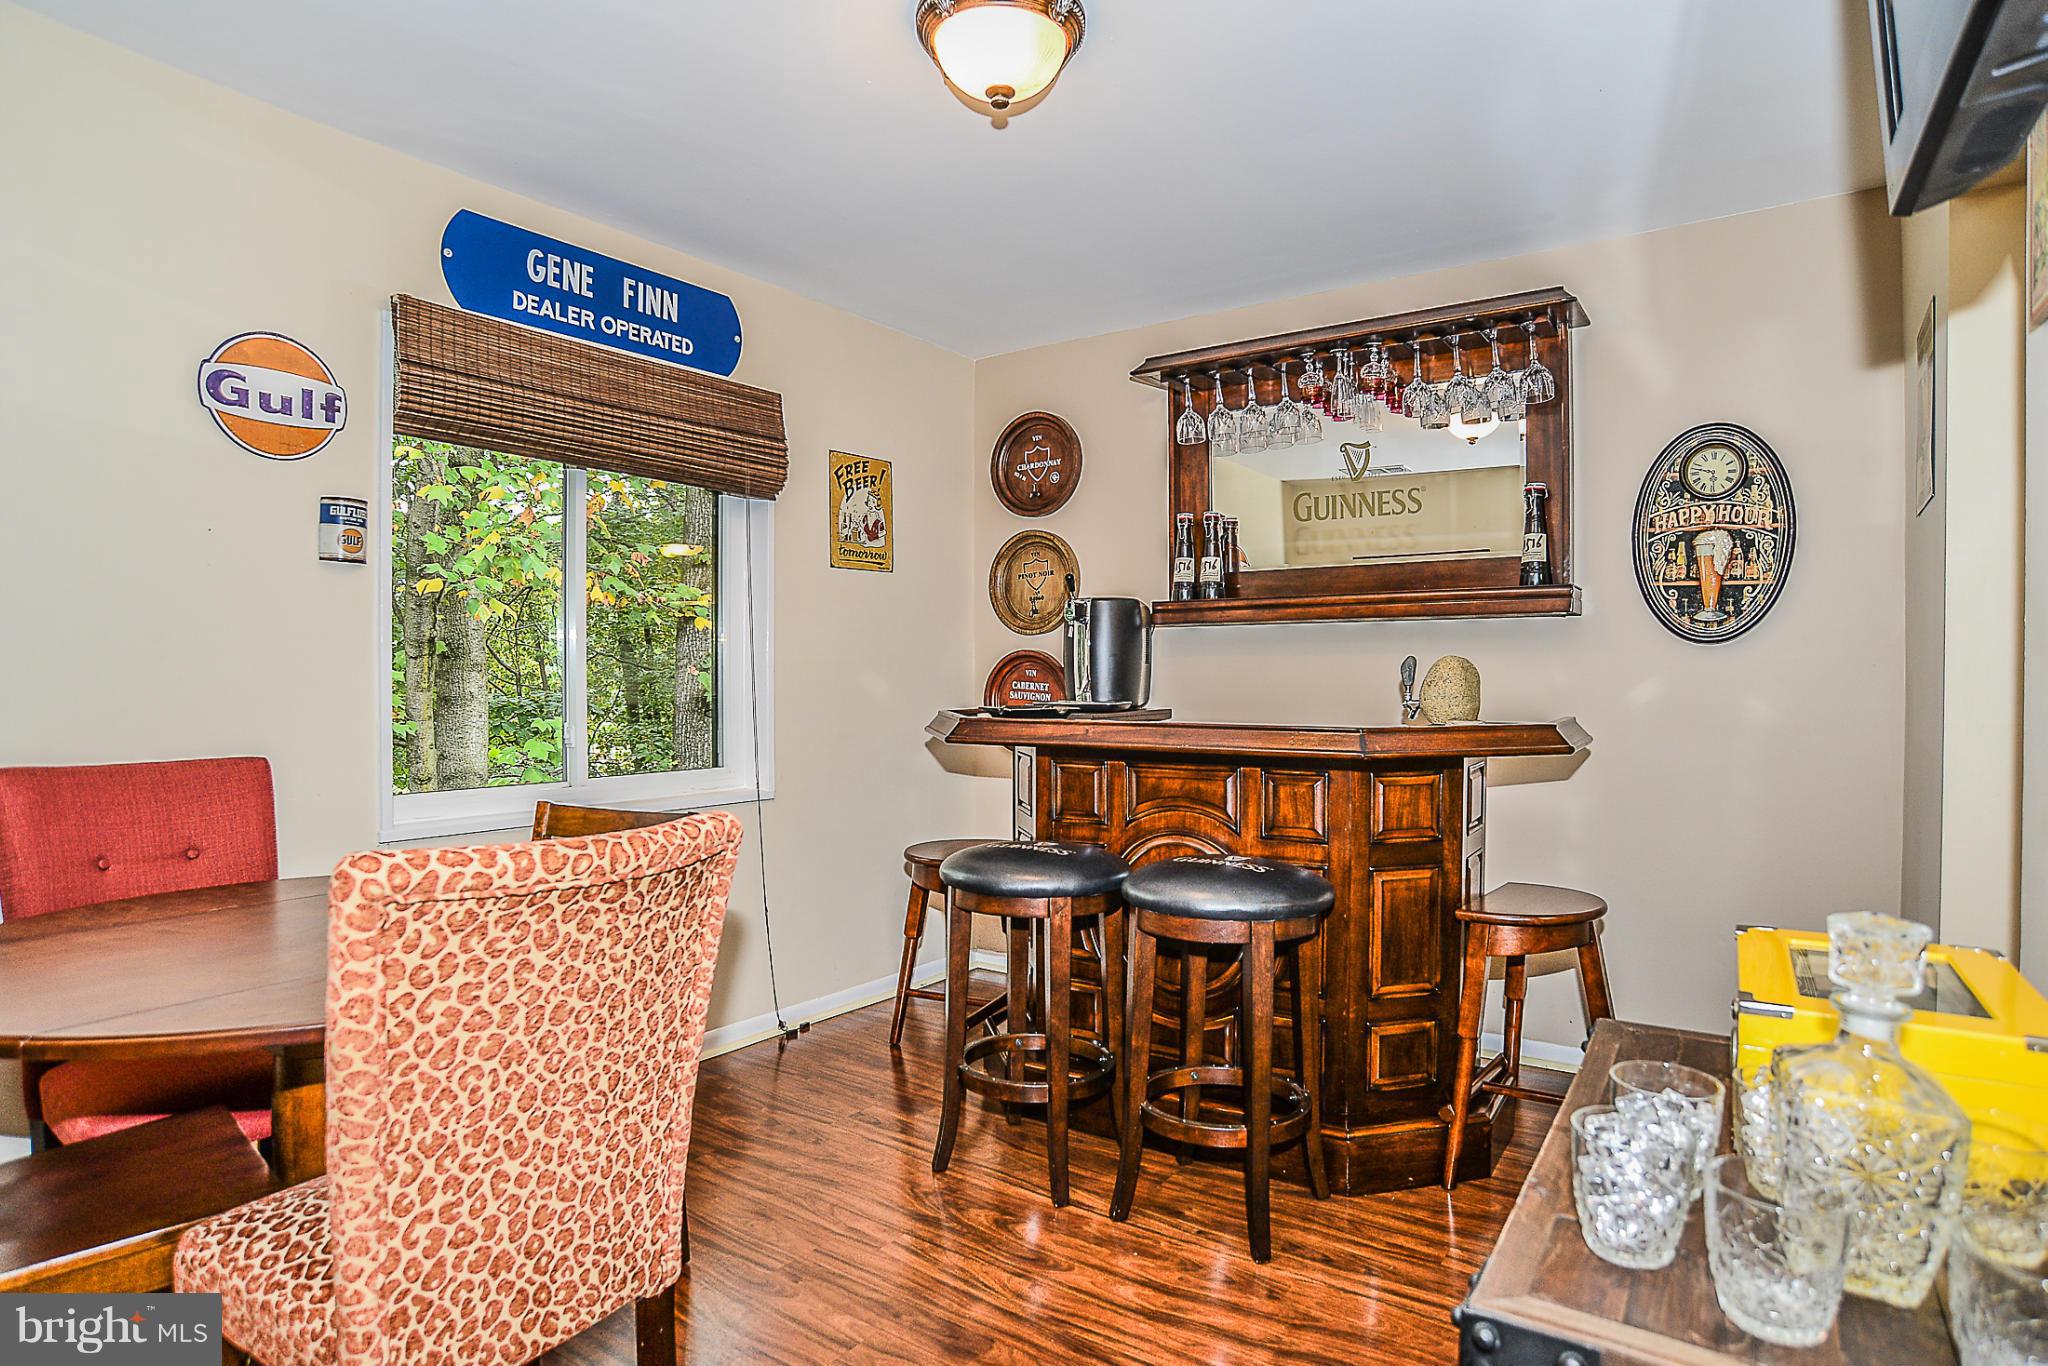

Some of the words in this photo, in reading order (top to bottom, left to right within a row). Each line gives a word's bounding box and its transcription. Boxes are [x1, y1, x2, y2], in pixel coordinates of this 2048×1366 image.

[527, 249, 594, 299] GENE
[623, 277, 678, 323] FINN
[512, 290, 595, 330] DEALER
[600, 316, 694, 355] OPERATED
[206, 369, 342, 423] Gulf
[834, 460, 869, 490] FREE
[1017, 458, 1061, 471] CHARDONNAY
[843, 469, 886, 503] BEER!
[1293, 487, 1423, 522] GUINNESS
[1653, 503, 1715, 534] HAPPY
[1715, 504, 1773, 530] HOUR
[838, 544, 887, 560] tomorrow
[1018, 572, 1037, 580] PINOT
[1038, 570, 1054, 578] NOIR
[1012, 680, 1050, 691] CABERNET
[1025, 669, 1037, 677] VIN
[1009, 690, 1051, 702] SAUVIGNON
